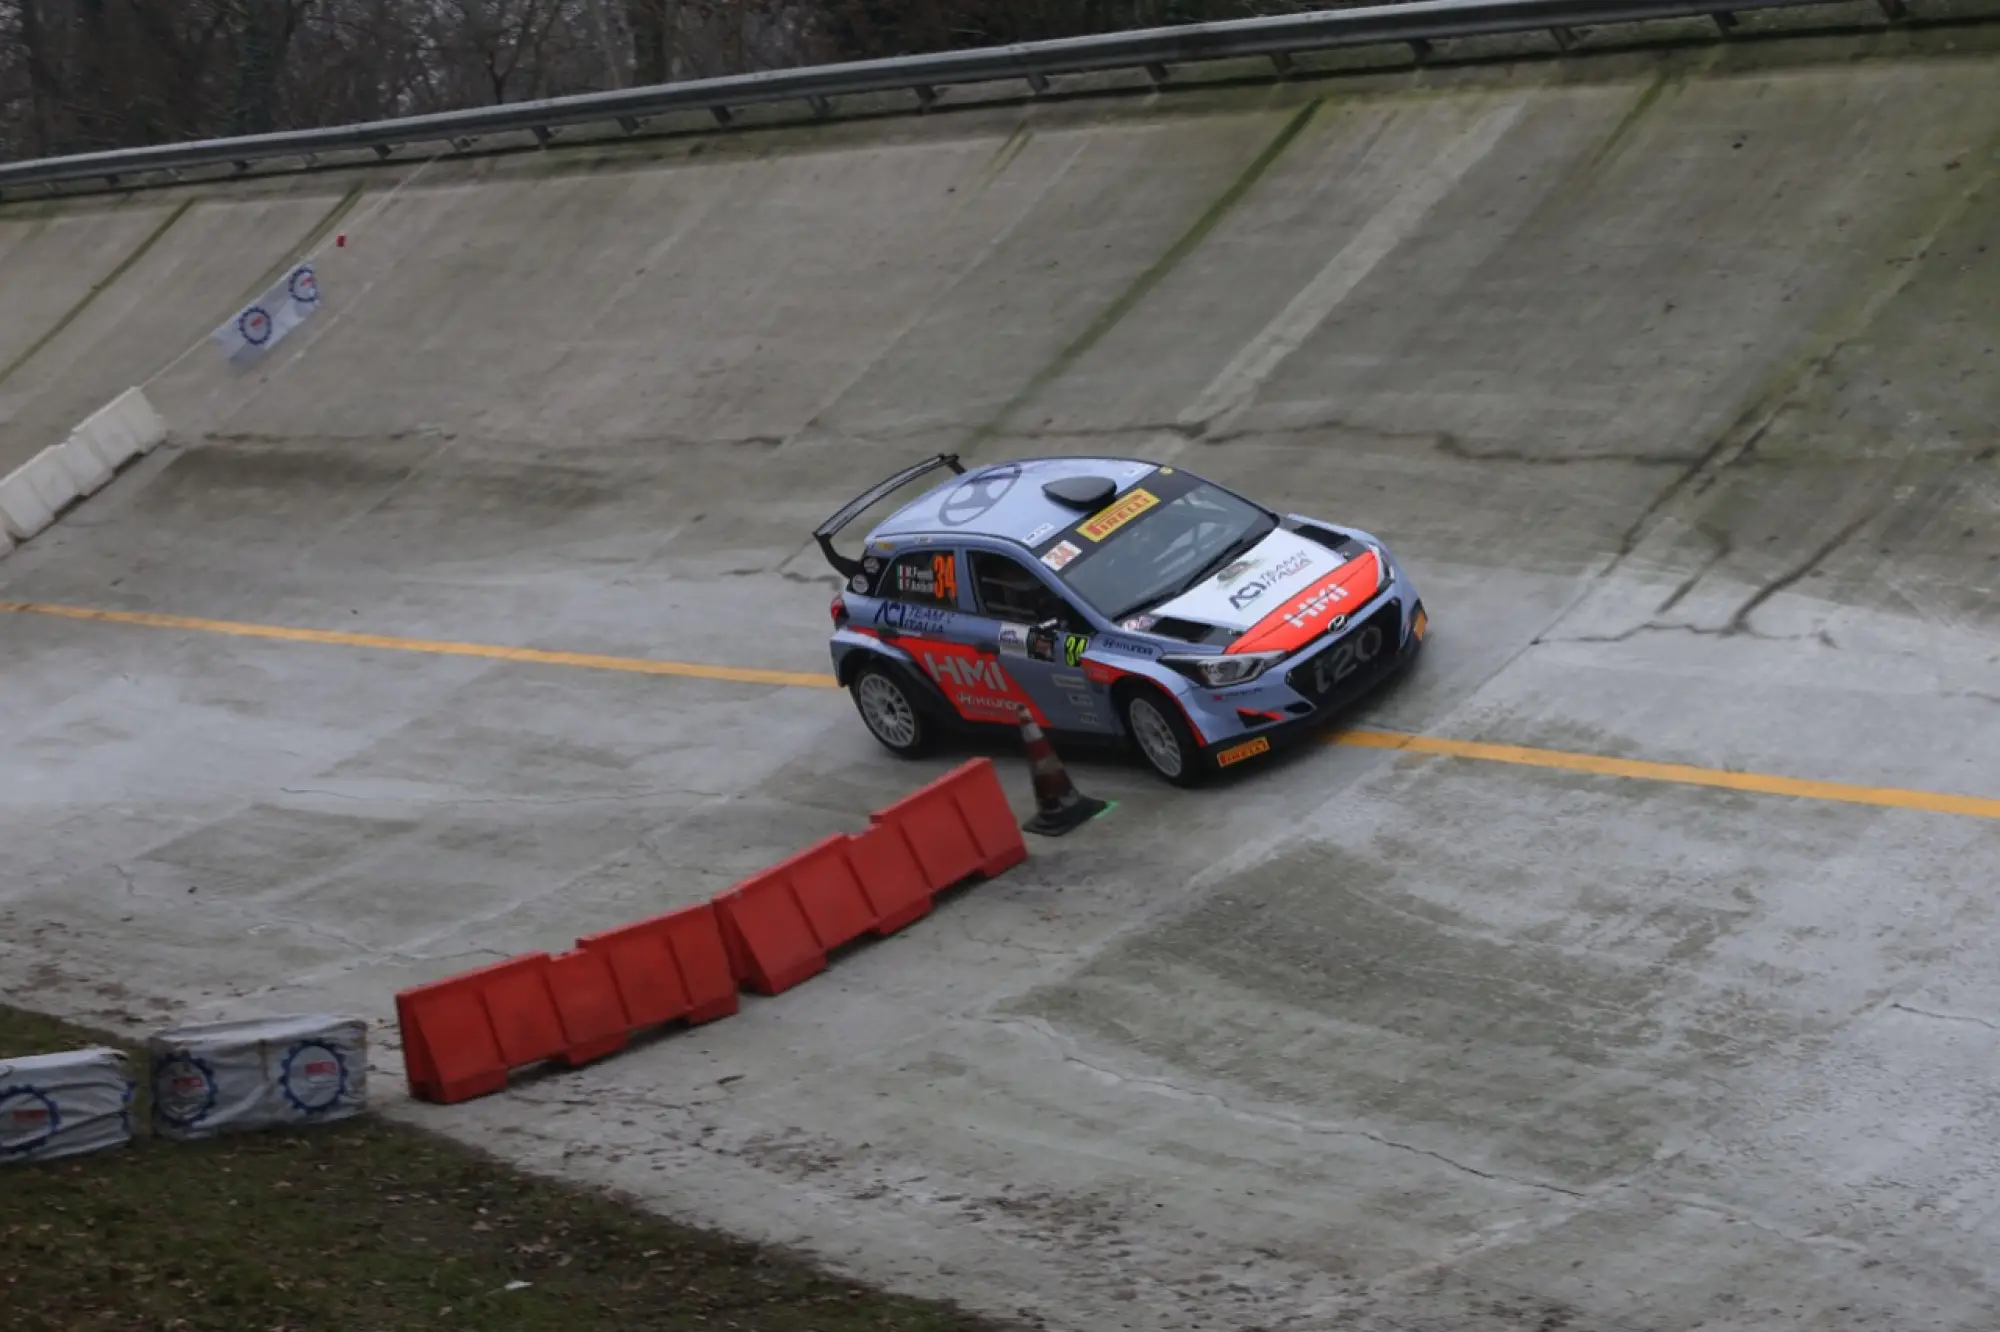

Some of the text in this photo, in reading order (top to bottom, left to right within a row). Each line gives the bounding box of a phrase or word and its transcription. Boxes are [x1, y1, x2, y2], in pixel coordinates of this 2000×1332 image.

[932, 555, 957, 598] 34
[904, 619, 943, 632] ITALIA
[1283, 583, 1348, 628] HMI
[924, 651, 1009, 692] HMI
[1314, 625, 1382, 693] i20
